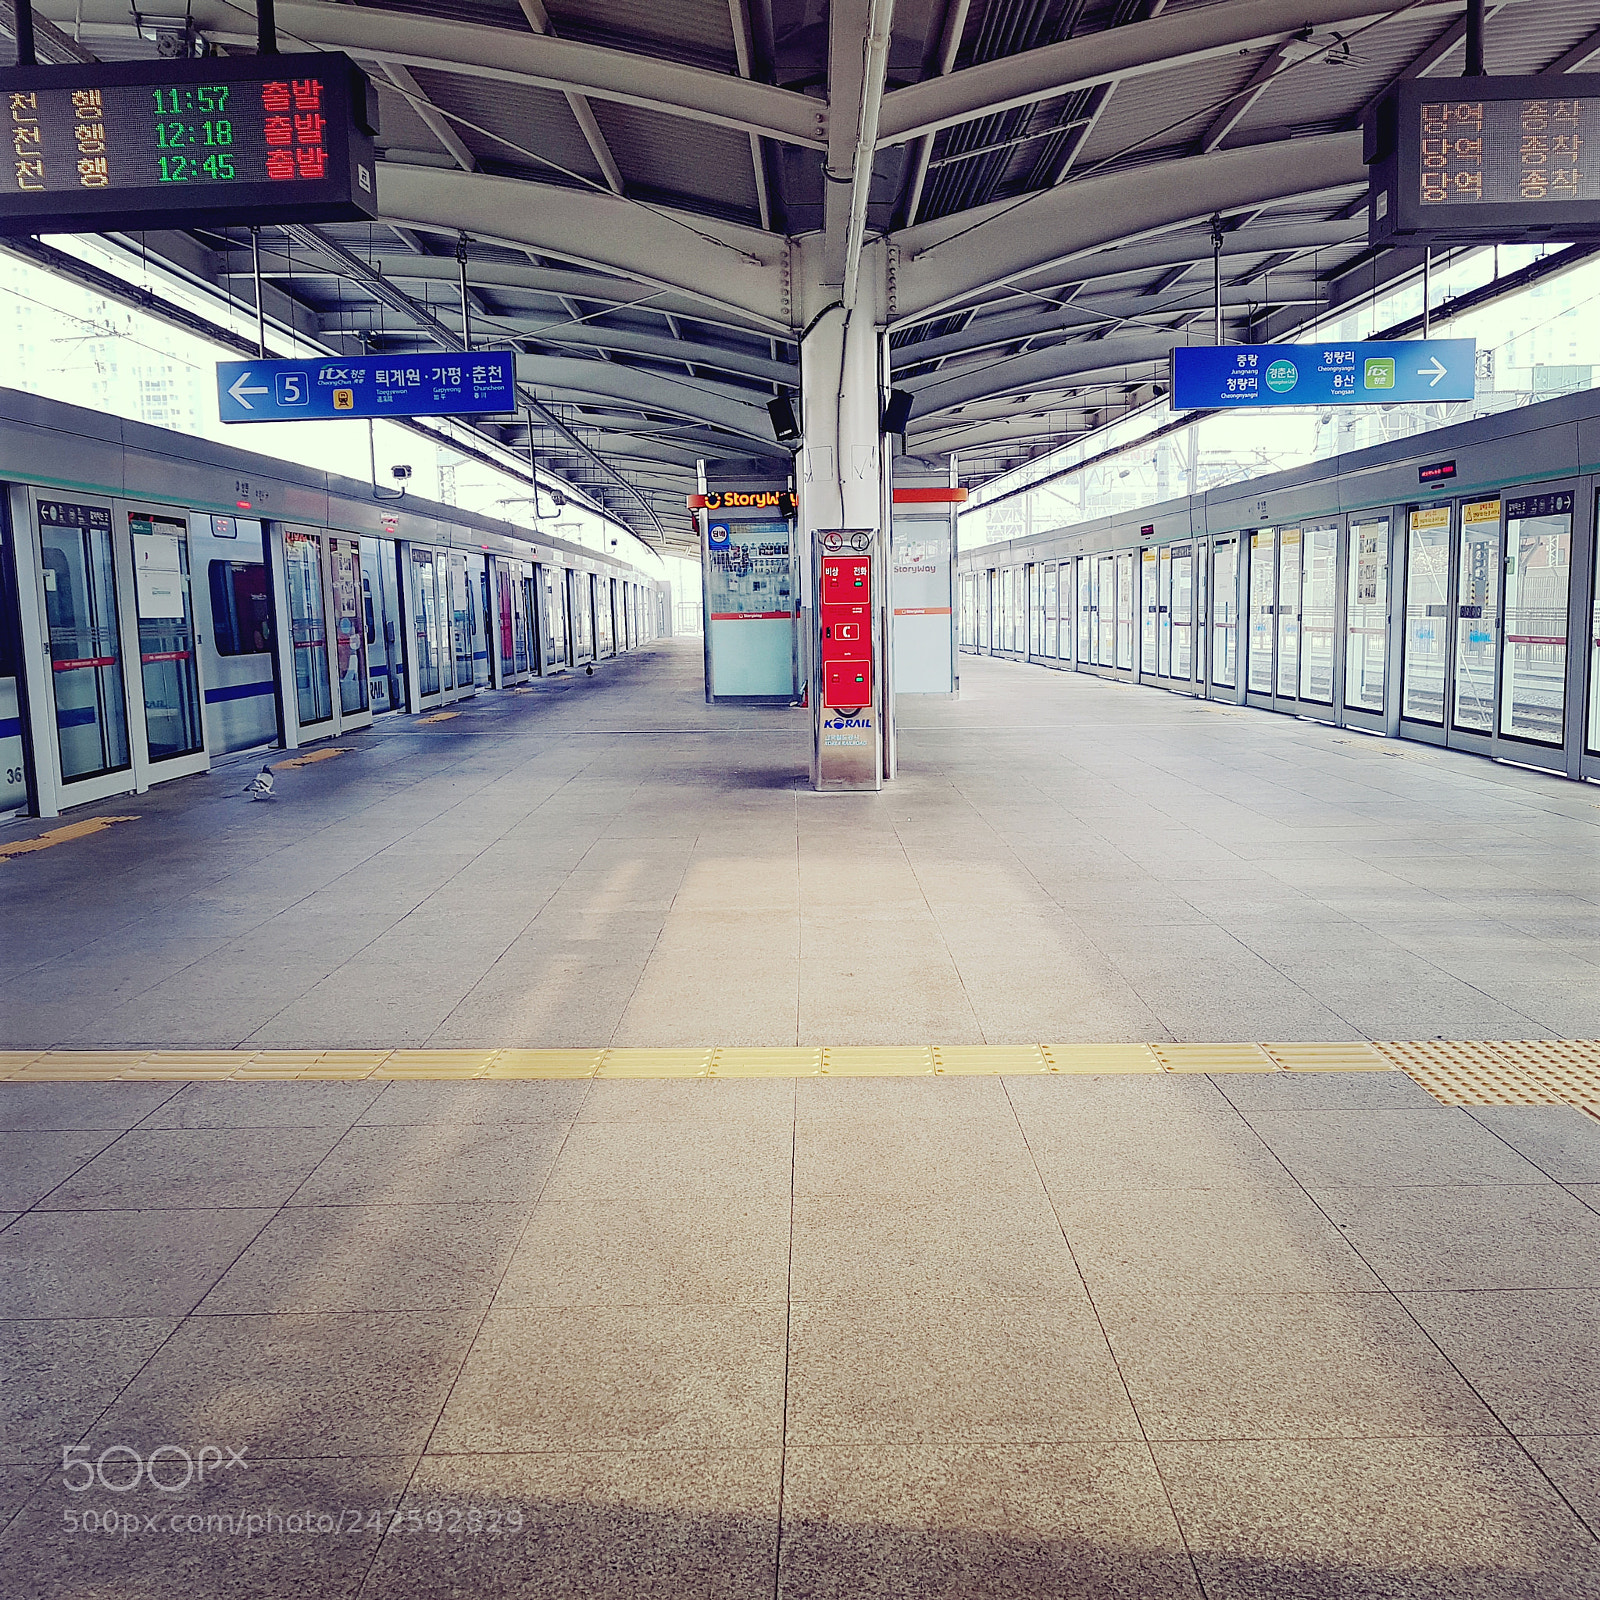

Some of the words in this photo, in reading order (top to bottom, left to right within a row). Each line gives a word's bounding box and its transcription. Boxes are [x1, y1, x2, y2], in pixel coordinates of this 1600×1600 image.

[9, 91, 38, 123] 천
[71, 89, 102, 119] 행
[152, 86, 230, 115] 11:57
[261, 79, 324, 111] 출발
[12, 125, 41, 157] 천
[74, 122, 105, 153] 행
[155, 120, 233, 149] 12:18
[264, 113, 327, 145] 출발
[1422, 137, 1483, 167] 당역
[14, 159, 45, 190] 천
[77, 156, 109, 187] 행
[158, 154, 235, 182] 12:45
[265, 147, 328, 180] 출발
[1421, 171, 1482, 201] 당역
[1236, 354, 1259, 367] 중랑
[1323, 351, 1355, 364] 청량리
[375, 368, 421, 387] 퇴계원
[431, 366, 462, 385] 가평
[472, 365, 503, 384] 춘천
[1269, 367, 1296, 379] 경춘선
[473, 384, 505, 392] Chuncheon
[1226, 377, 1258, 391] 청량리
[1333, 374, 1355, 388] 용산
[284, 377, 301, 402] 5
[1330, 388, 1355, 396] Yongsan
[724, 491, 799, 508] StoryWy
[825, 567, 839, 577] 비상
[893, 565, 936, 574] StoryWay
[824, 717, 872, 729] KORAIL
[6, 766, 22, 784] 36
